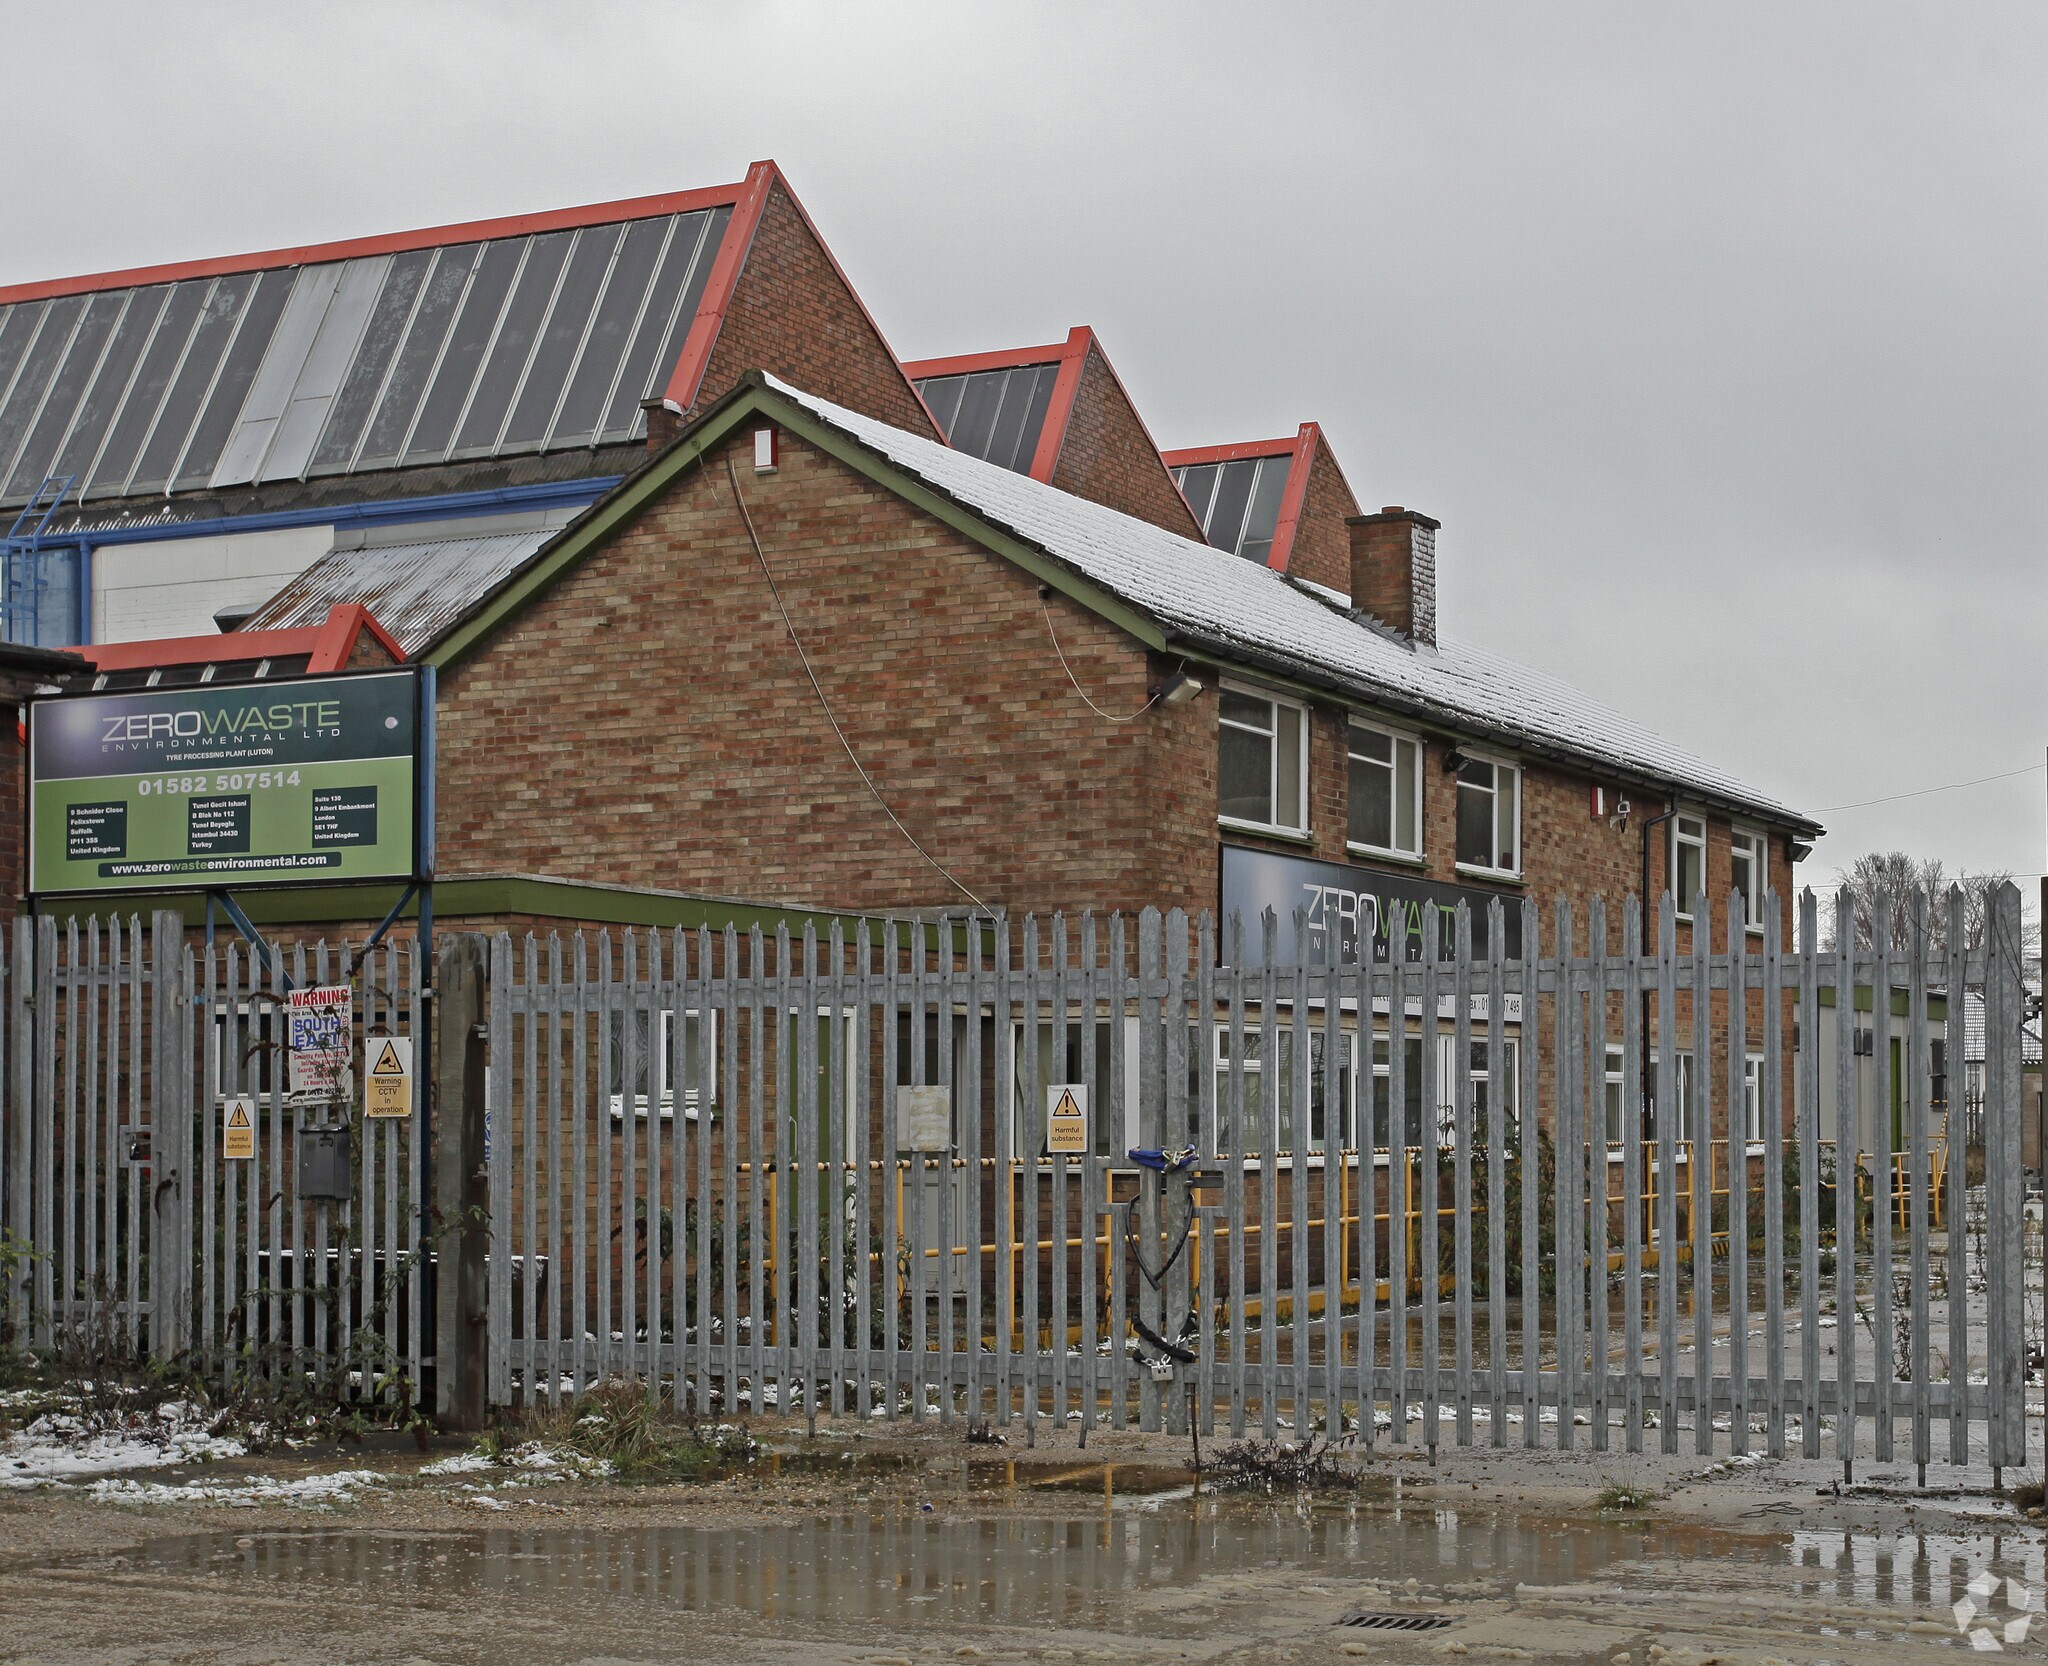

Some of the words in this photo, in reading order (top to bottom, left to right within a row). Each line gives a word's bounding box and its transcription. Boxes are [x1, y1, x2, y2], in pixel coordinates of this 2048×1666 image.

[102, 700, 340, 742] ZEROWASTE
[102, 735, 286, 752] ENVIRONMENTAL
[303, 728, 340, 738] LTD
[183, 751, 224, 760] PROCESSING
[225, 749, 246, 757] PLANT
[247, 747, 273, 757] (LUTON)
[139, 776, 207, 796] 01582
[215, 770, 301, 791] 507514
[92, 846, 121, 854] Kingdom
[191, 841, 213, 849] Turkey
[112, 855, 327, 874] www.zerowasteenvironmental.com
[292, 989, 349, 1007] WARNING
[294, 1017, 341, 1033] SOUTH
[374, 1077, 402, 1087] Warning
[378, 1088, 398, 1096] CCTV
[372, 1106, 404, 1114] operation
